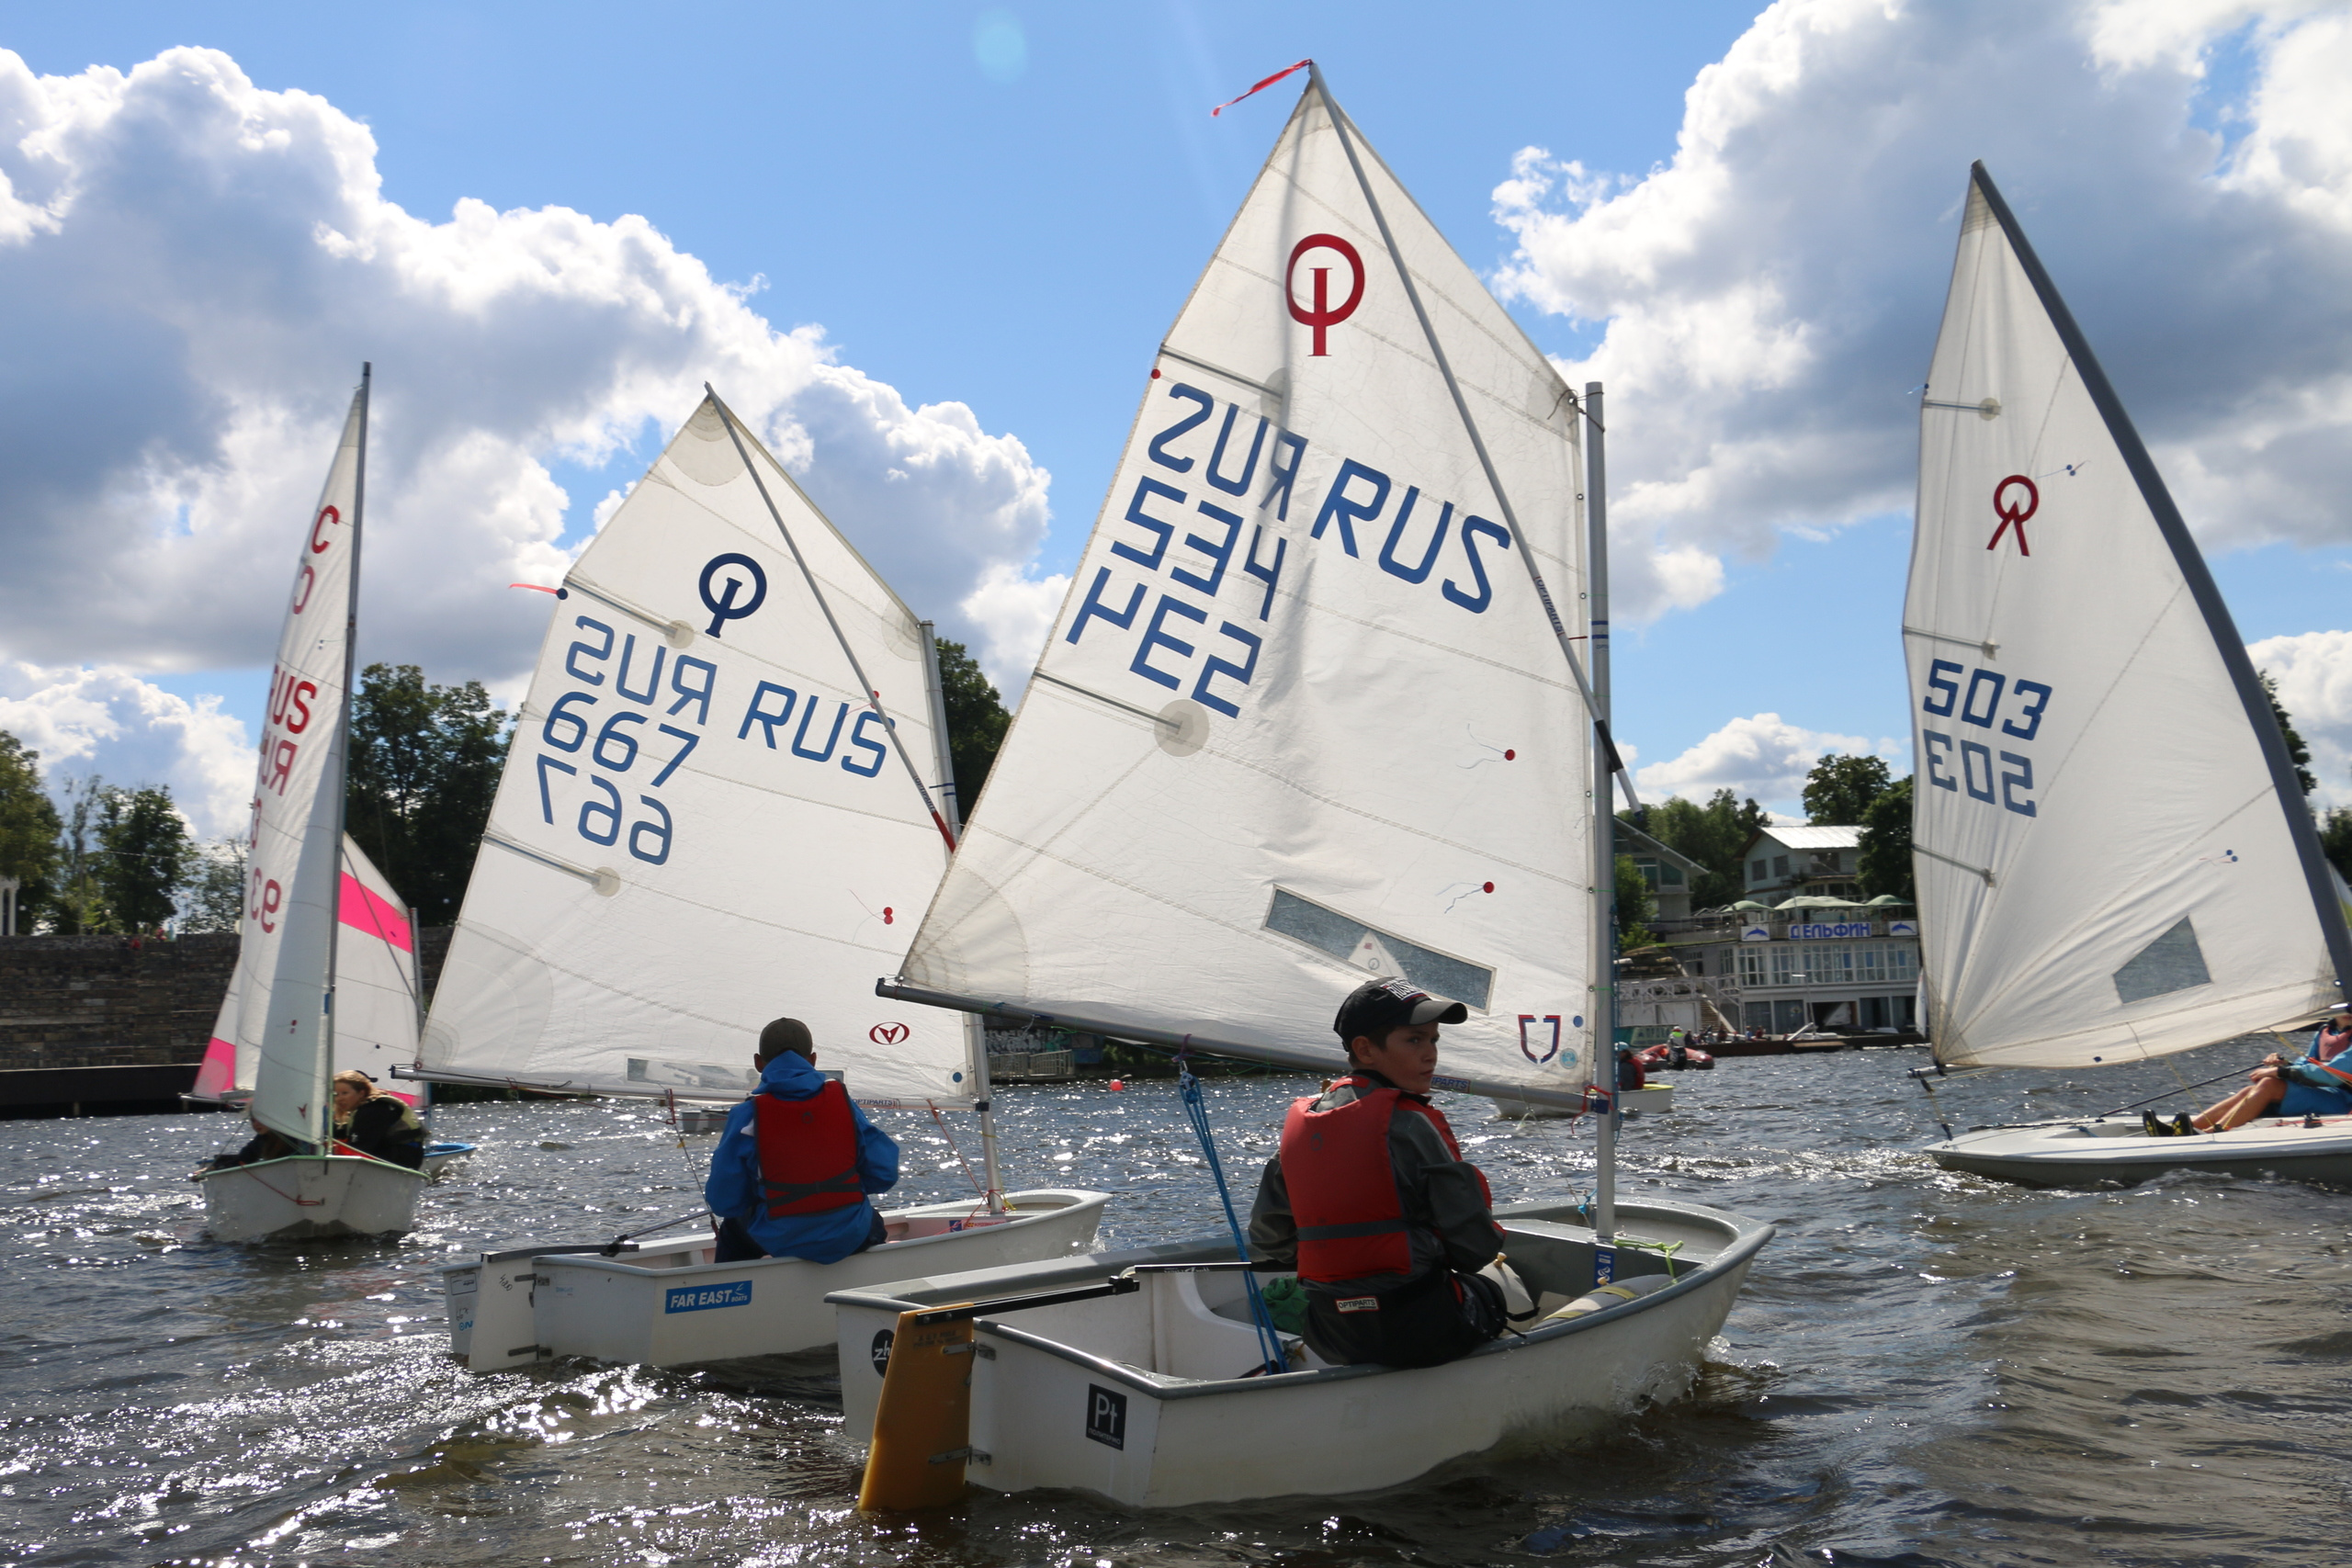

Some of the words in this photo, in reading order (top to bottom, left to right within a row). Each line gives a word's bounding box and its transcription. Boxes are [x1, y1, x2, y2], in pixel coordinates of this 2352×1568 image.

[1111, 476, 1287, 622] 534
[1310, 457, 1510, 614] RUS
[542, 691, 700, 787] 667
[738, 680, 896, 778] RUS
[1923, 658, 2052, 741] 503
[1790, 922, 1871, 939] ДЕЛЬФИН
[670, 1293, 696, 1309] FAR
[699, 1289, 733, 1305] EAST
[1338, 1299, 1375, 1309] OPTIPARTS
[1095, 1393, 1118, 1434] Pt
